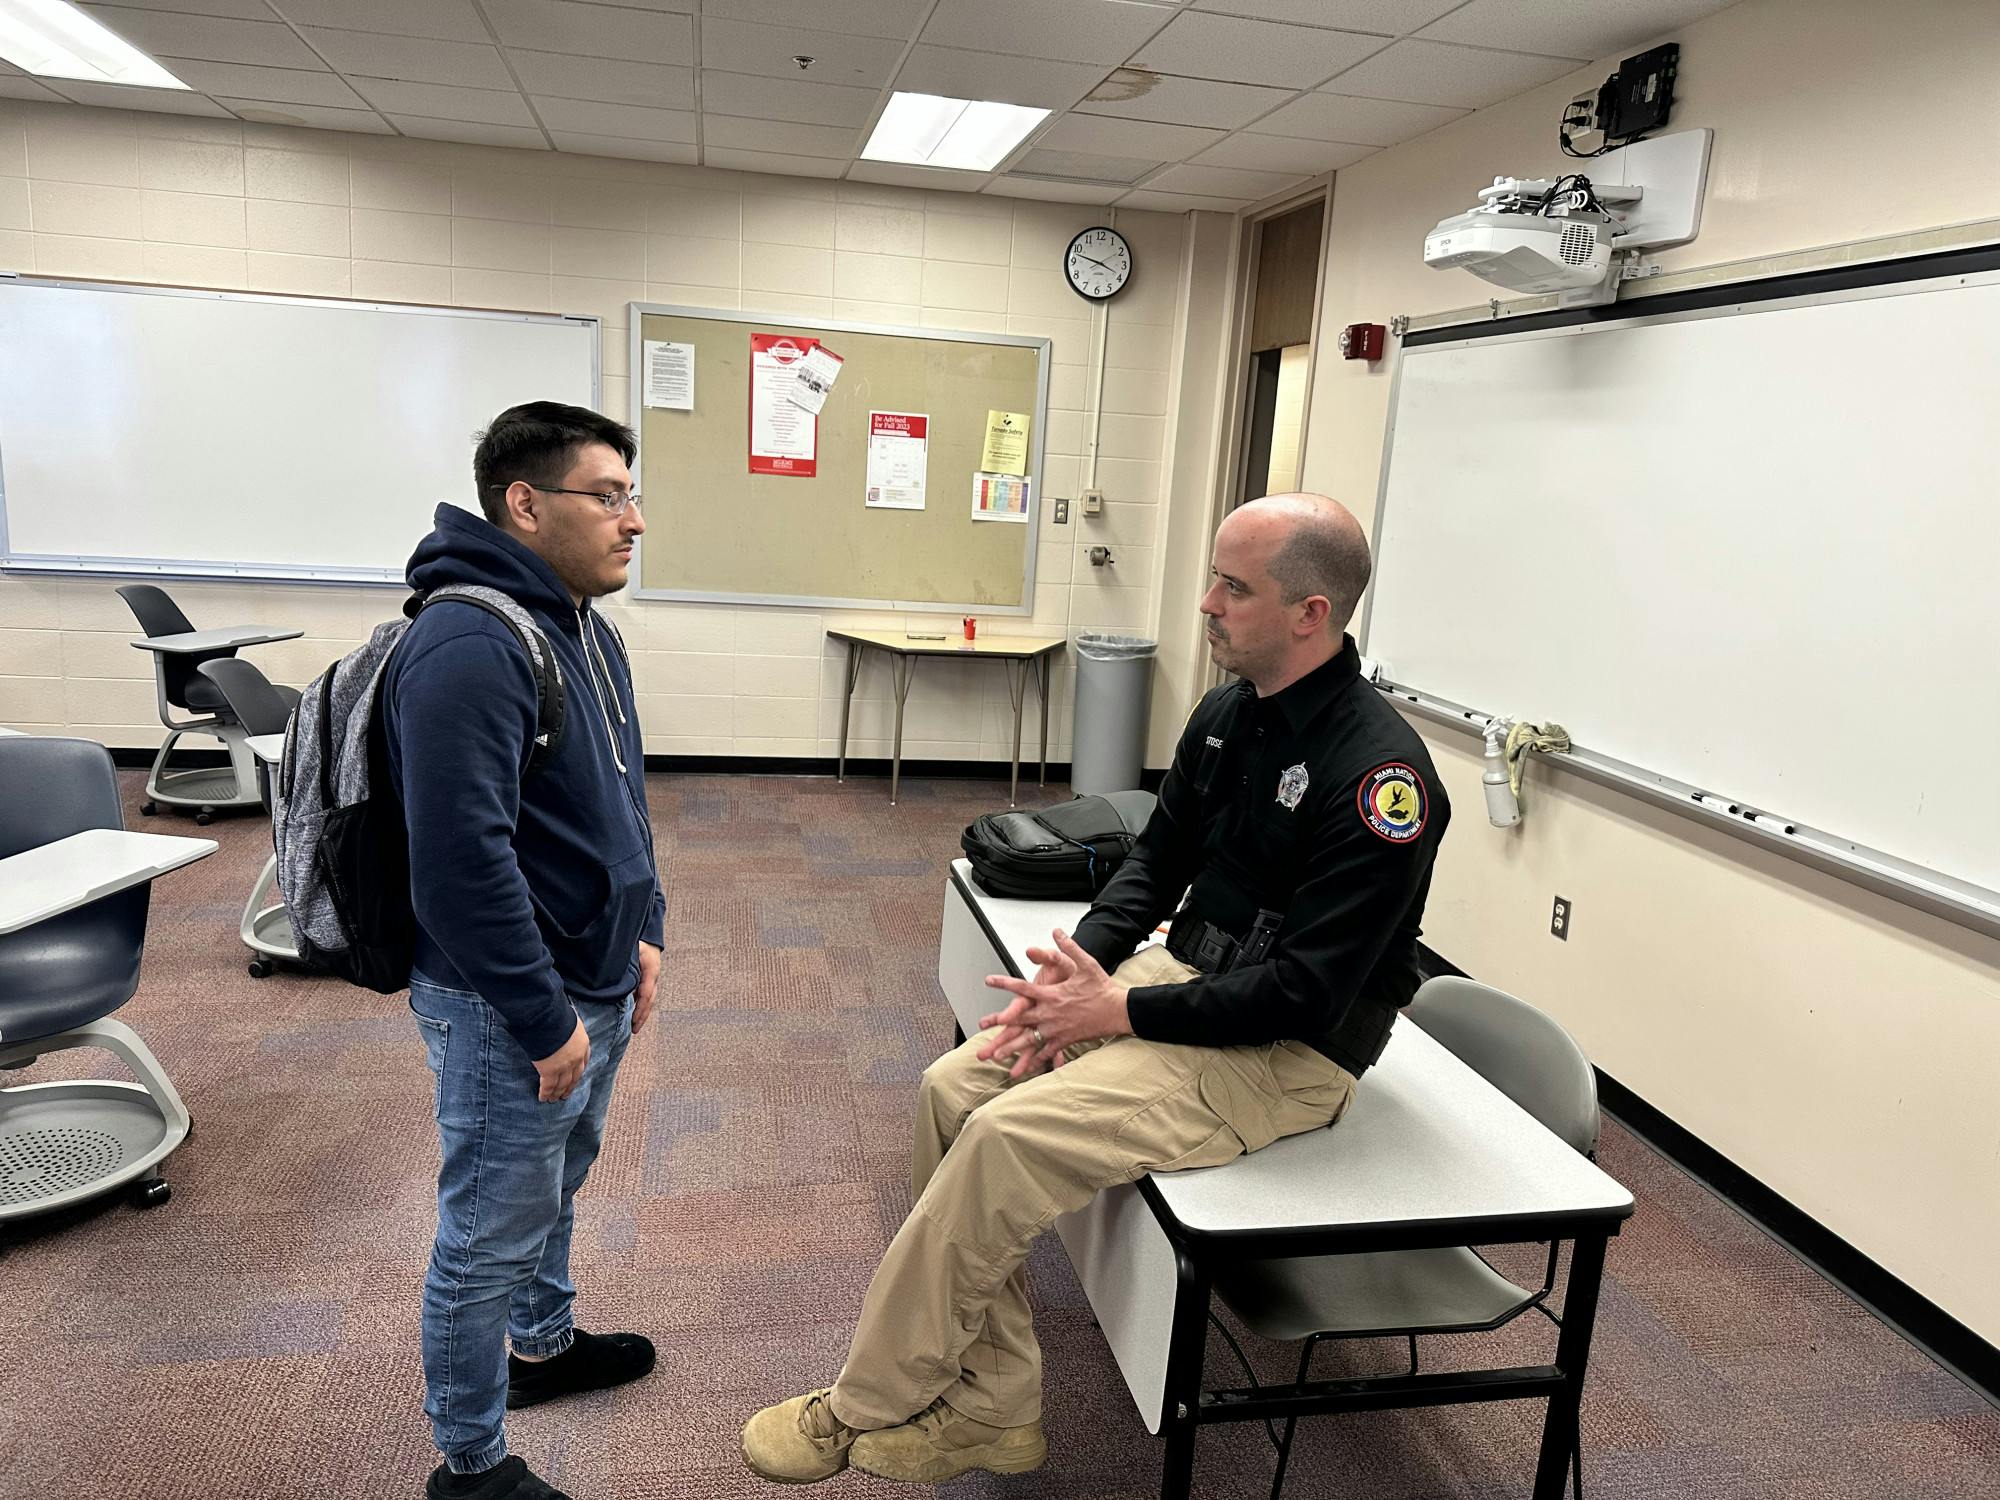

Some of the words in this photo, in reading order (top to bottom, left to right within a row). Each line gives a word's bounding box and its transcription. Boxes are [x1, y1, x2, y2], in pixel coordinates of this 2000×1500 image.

[1085, 235, 1092, 244] 11
[1096, 232, 1106, 240] 12
[1074, 244, 1082, 253] 10
[1118, 247, 1124, 256] 2
[1071, 257, 1076, 265] 9
[1121, 261, 1127, 270] 3
[1073, 270, 1079, 279] 8
[1116, 273, 1122, 282] 4
[1082, 282, 1088, 290] 7
[1094, 286, 1100, 295] 6
[1106, 283, 1112, 292] 5
[883, 416, 906, 424] Advised
[1373, 767, 1394, 781] MIAMI
[1395, 767, 1416, 783] NATION
[1367, 815, 1390, 836] POLICE
